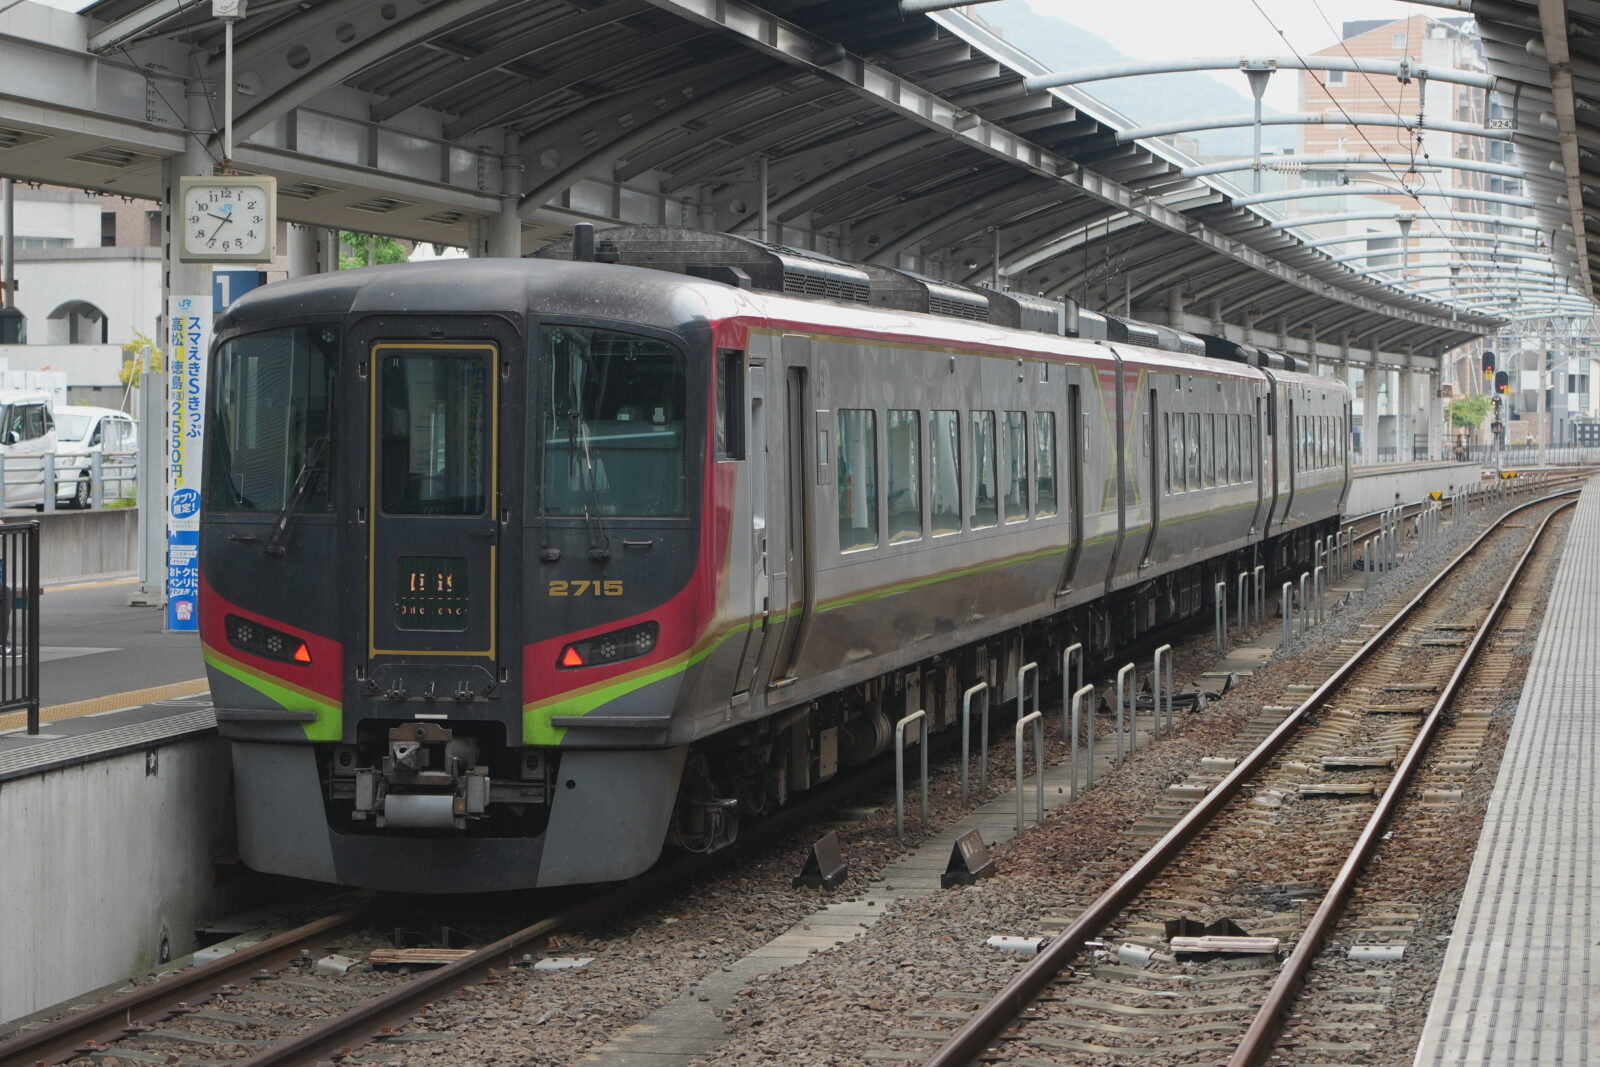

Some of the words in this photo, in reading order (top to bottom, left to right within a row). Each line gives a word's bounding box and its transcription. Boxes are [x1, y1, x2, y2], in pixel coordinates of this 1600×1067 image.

[209, 194, 218, 202] 11
[220, 190, 232, 198] 12
[237, 193, 242, 201] 1
[198, 203, 209, 211] 10
[219, 204, 233, 212] JR
[247, 201, 255, 210] 2
[192, 215, 200, 223] 9
[252, 215, 260, 224] 3
[197, 229, 205, 238] 8
[246, 229, 254, 238] 4
[210, 238, 217, 246] 7
[222, 241, 230, 249] 6
[235, 238, 243, 246] 5
[216, 275, 231, 308] 1
[178, 299, 192, 307] JR
[186, 316, 202, 438] スマえきSきっぷ
[173, 492, 197, 505] アプリ
[548, 580, 624, 597] 2715
